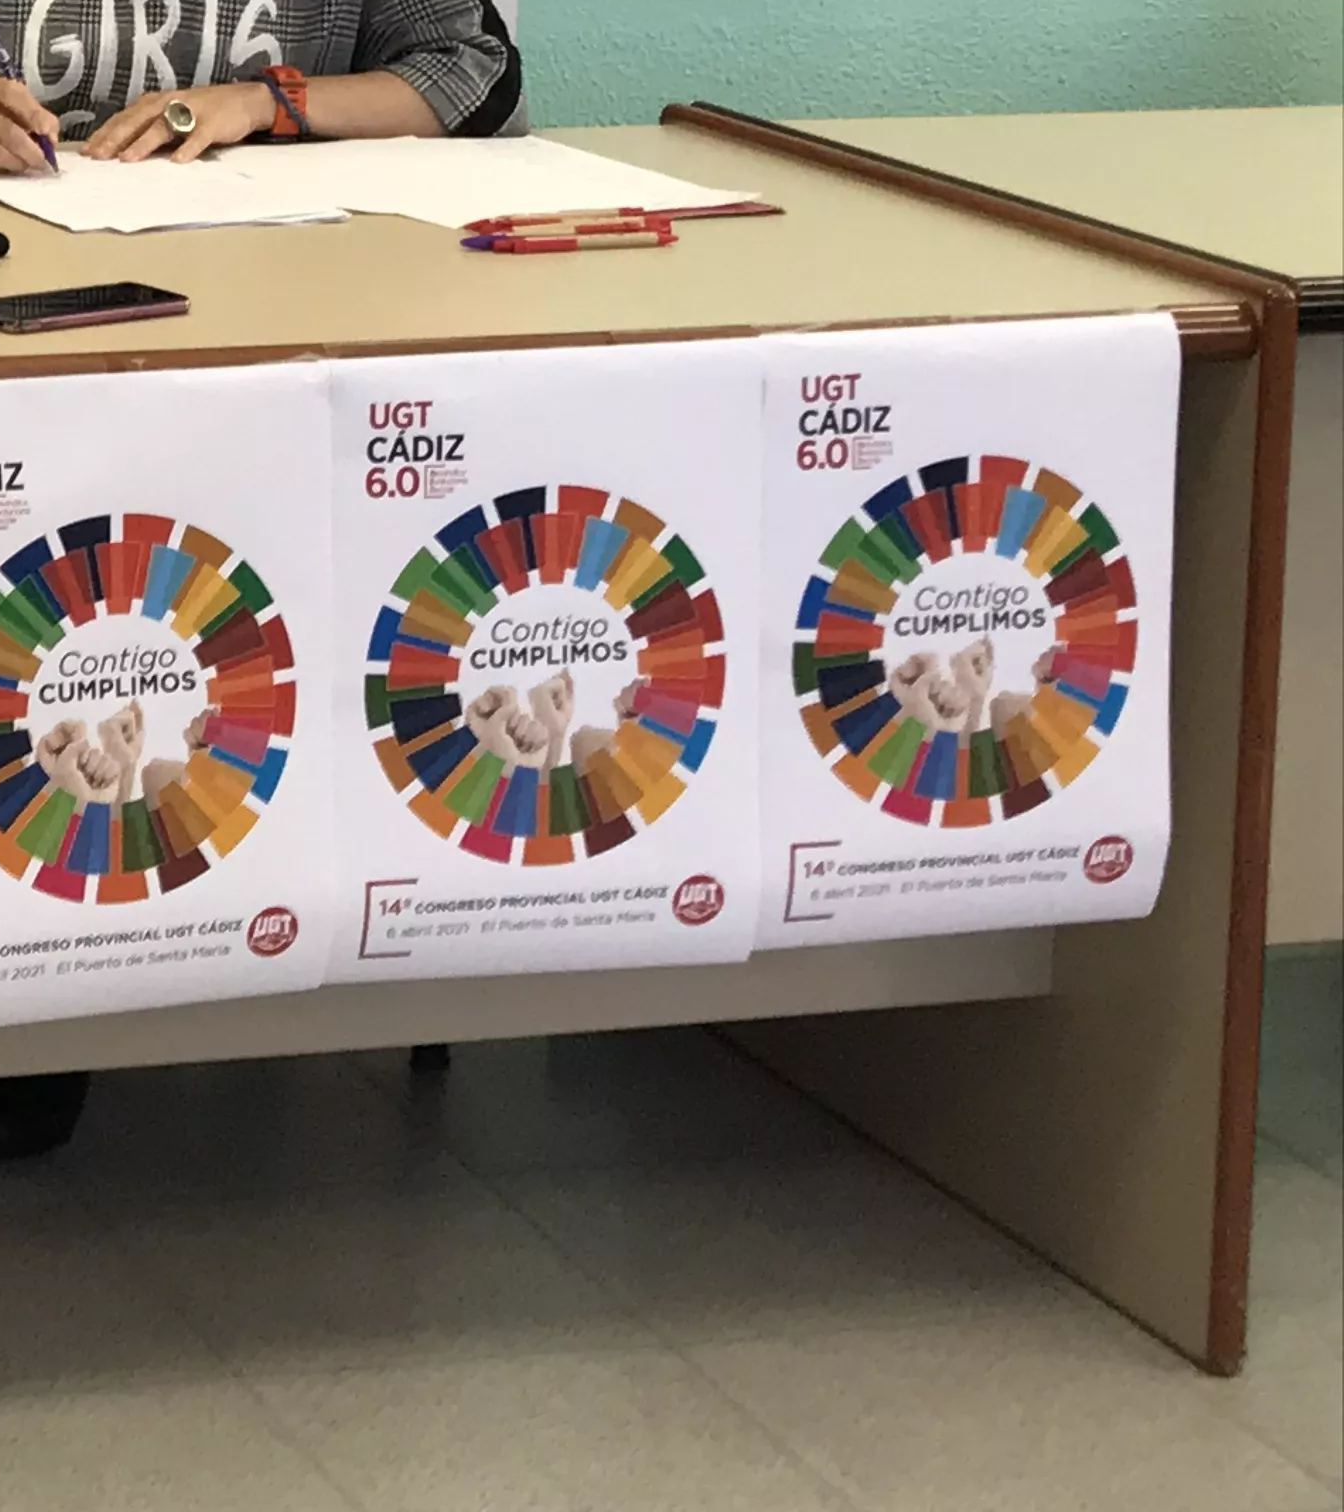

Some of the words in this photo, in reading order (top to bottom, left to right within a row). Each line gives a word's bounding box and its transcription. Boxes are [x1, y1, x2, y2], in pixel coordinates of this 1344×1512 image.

[802, 374, 861, 401] UGT
[369, 402, 432, 429] UGT
[798, 403, 891, 435] CÁDIZ
[367, 429, 464, 462] CÁDIZ
[796, 439, 847, 470] 6.0
[366, 466, 419, 498] 6.0
[914, 583, 1028, 612] Contigo
[491, 615, 609, 644] Contigo
[894, 608, 1047, 637] CUMPLIMOS
[59, 645, 177, 678] Contigo
[469, 641, 628, 669] CUMPLIMOS
[38, 671, 197, 704] CUMPLIMOS
[75, 930, 161, 949] PROVINCIAL
[165, 927, 195, 939] UGT
[198, 919, 243, 936] CÁDIZ
